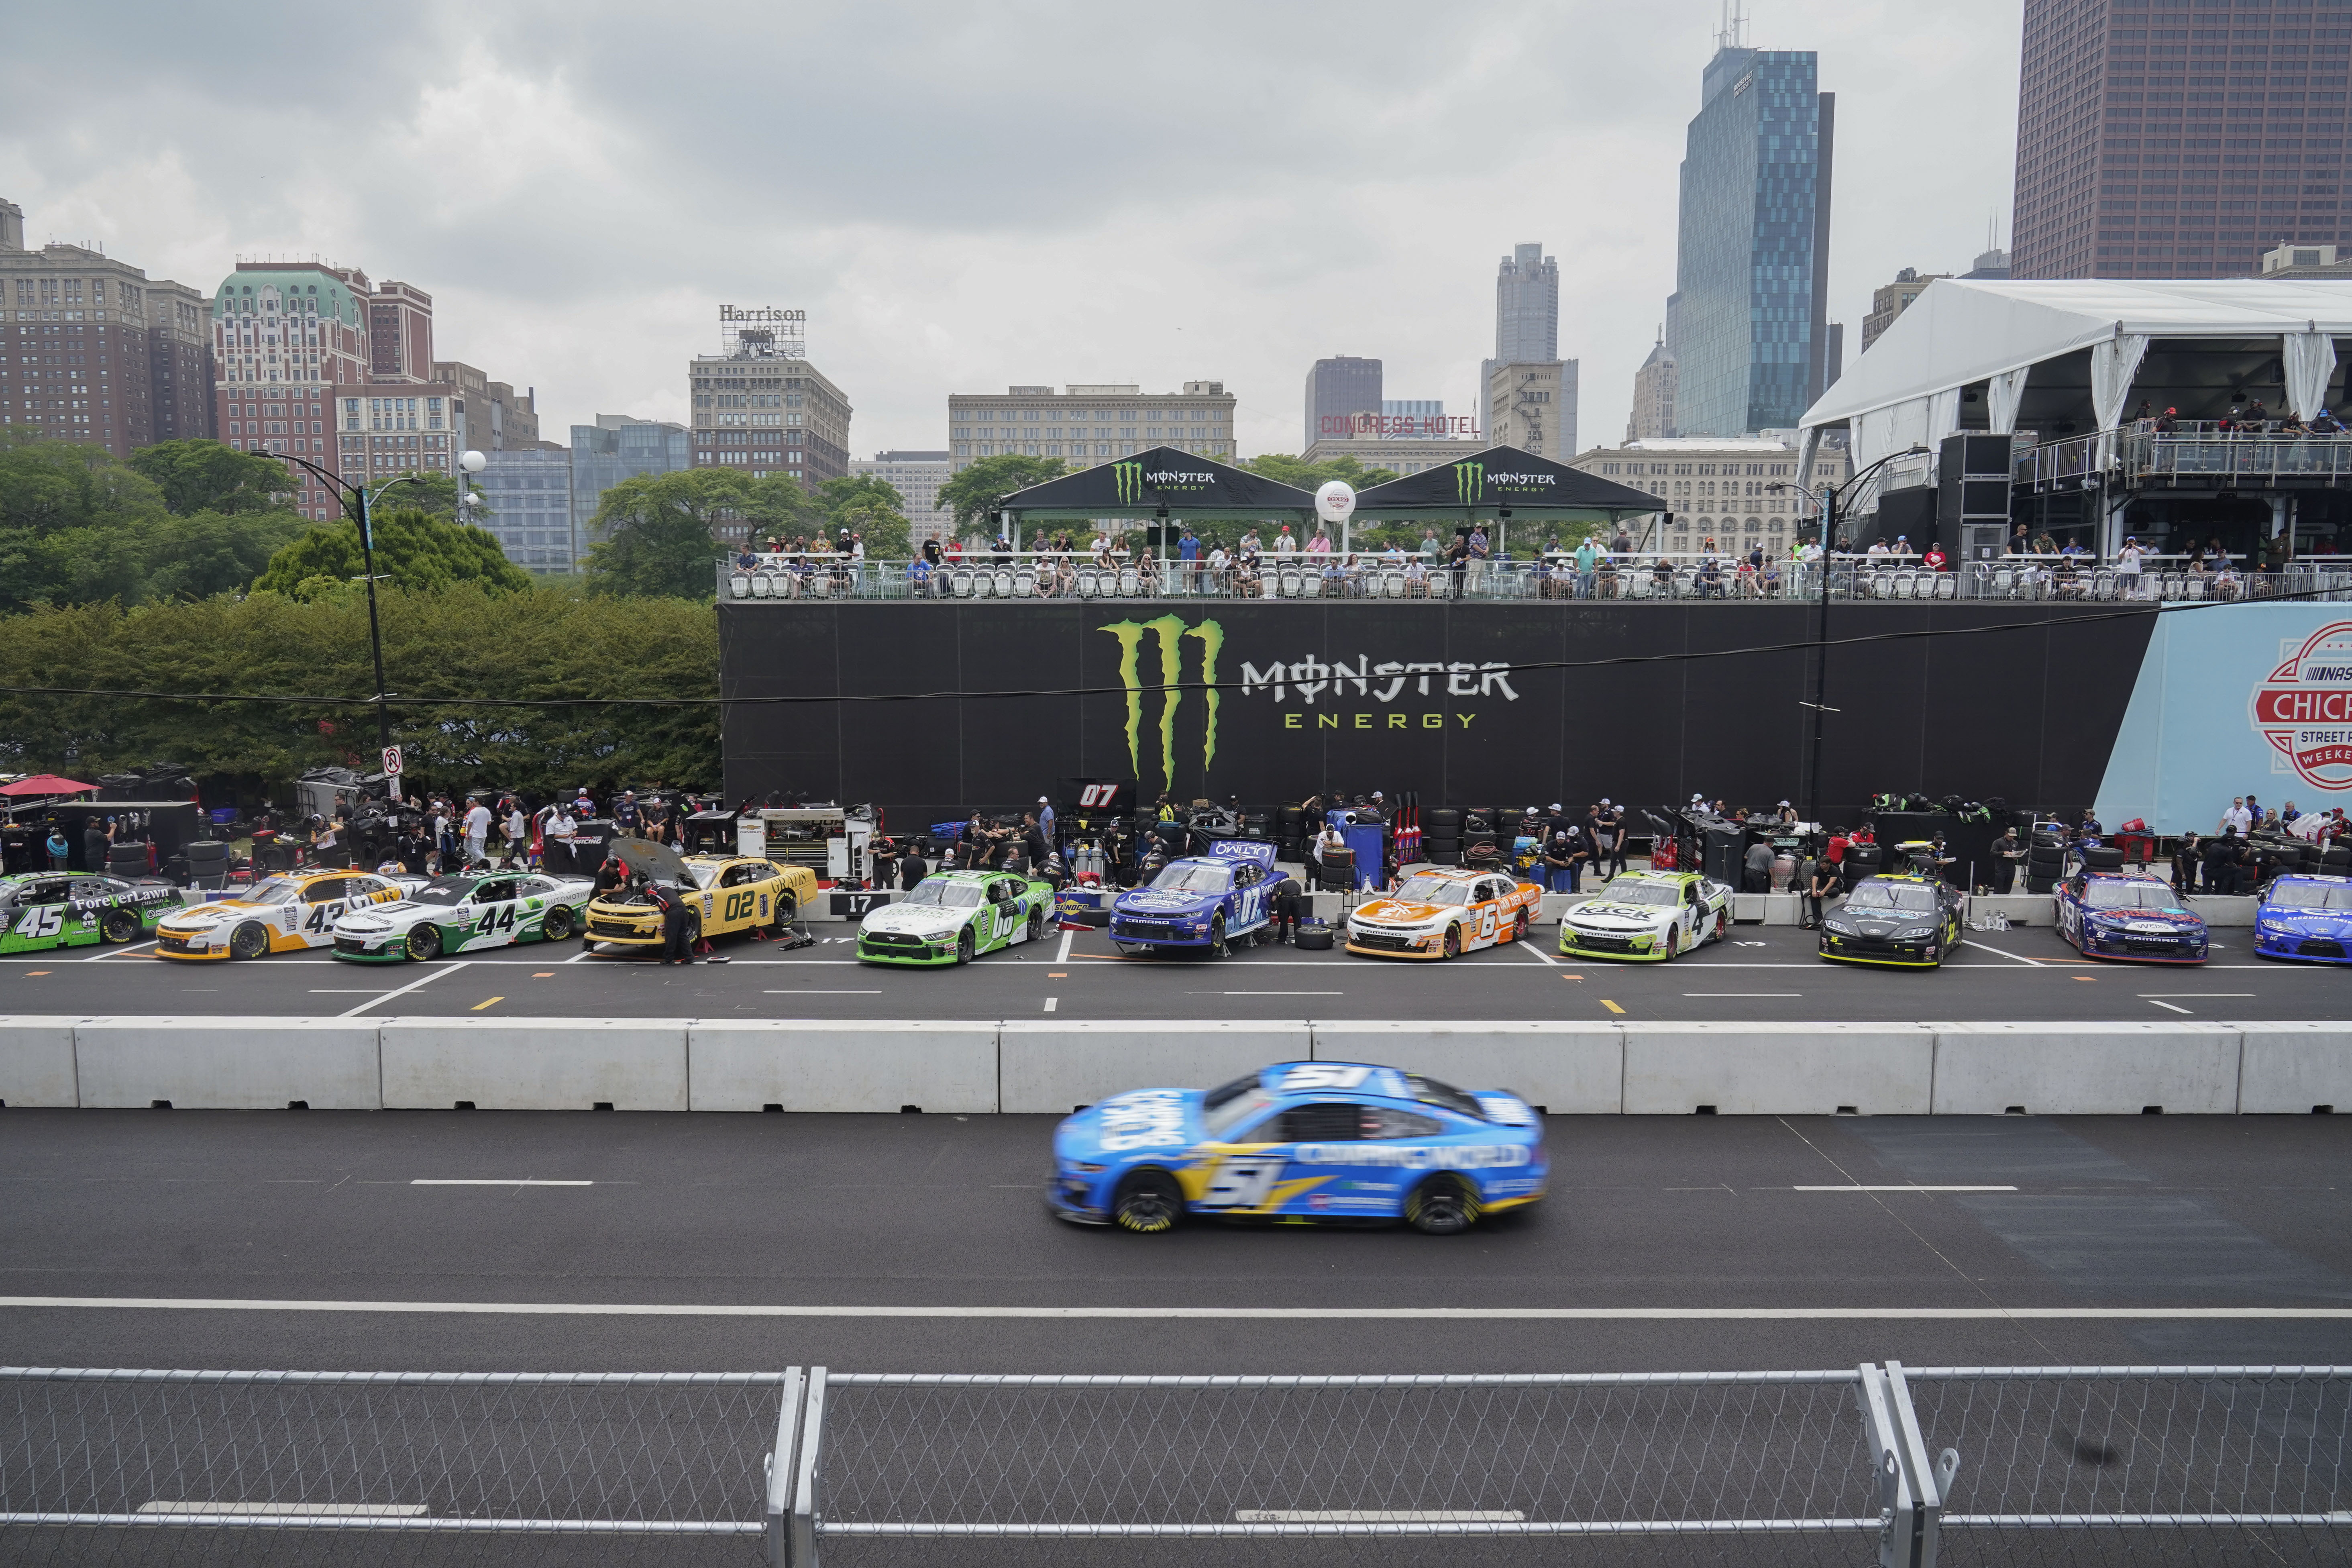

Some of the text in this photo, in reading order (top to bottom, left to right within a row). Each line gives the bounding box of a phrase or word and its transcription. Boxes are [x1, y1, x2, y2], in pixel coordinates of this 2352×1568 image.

[1734, 70, 1753, 92] ROOSEVELT
[719, 305, 806, 321] Harrison
[754, 326, 796, 335] HOTEL
[1321, 416, 1481, 434] CONGRESS HOTEL
[1146, 471, 1215, 483] MONSTER
[1487, 472, 1556, 485] MONSTER
[1240, 654, 1519, 704] MONSTER
[1285, 714, 1476, 728] ENERGY
[2301, 732, 2345, 742] STREET
[1080, 784, 1118, 807] 07
[1216, 844, 1270, 857] ULTIMO
[771, 871, 806, 893] GRATIS
[546, 890, 590, 906] AUTOMOTIVE
[725, 890, 755, 922] 02
[776, 893, 793, 906] GOODYEAR
[850, 896, 871, 912] 17
[1241, 887, 1260, 925] 07
[1498, 889, 1535, 909] VAN DER HAGEN
[123, 909, 137, 918] EAGLE
[156, 905, 181, 913] PRECISION
[884, 912, 951, 920] SOLUTIONS
[890, 908, 959, 916] CLUBFOOT
[1573, 906, 1657, 920] KICK
[16, 905, 65, 938] 45
[305, 902, 345, 934] 43
[477, 903, 515, 935] 44
[1480, 903, 1497, 938] 6
[104, 925, 129, 942] GOODYEAR
[233, 927, 241, 943] EAGLE
[428, 926, 439, 938] EAGLE
[545, 928, 569, 940] GOODYEAR
[252, 930, 267, 957] GOODYEAR
[406, 937, 426, 960] GOODYEAR
[1280, 1065, 1375, 1089] 51
[1204, 1159, 1286, 1205] 51
